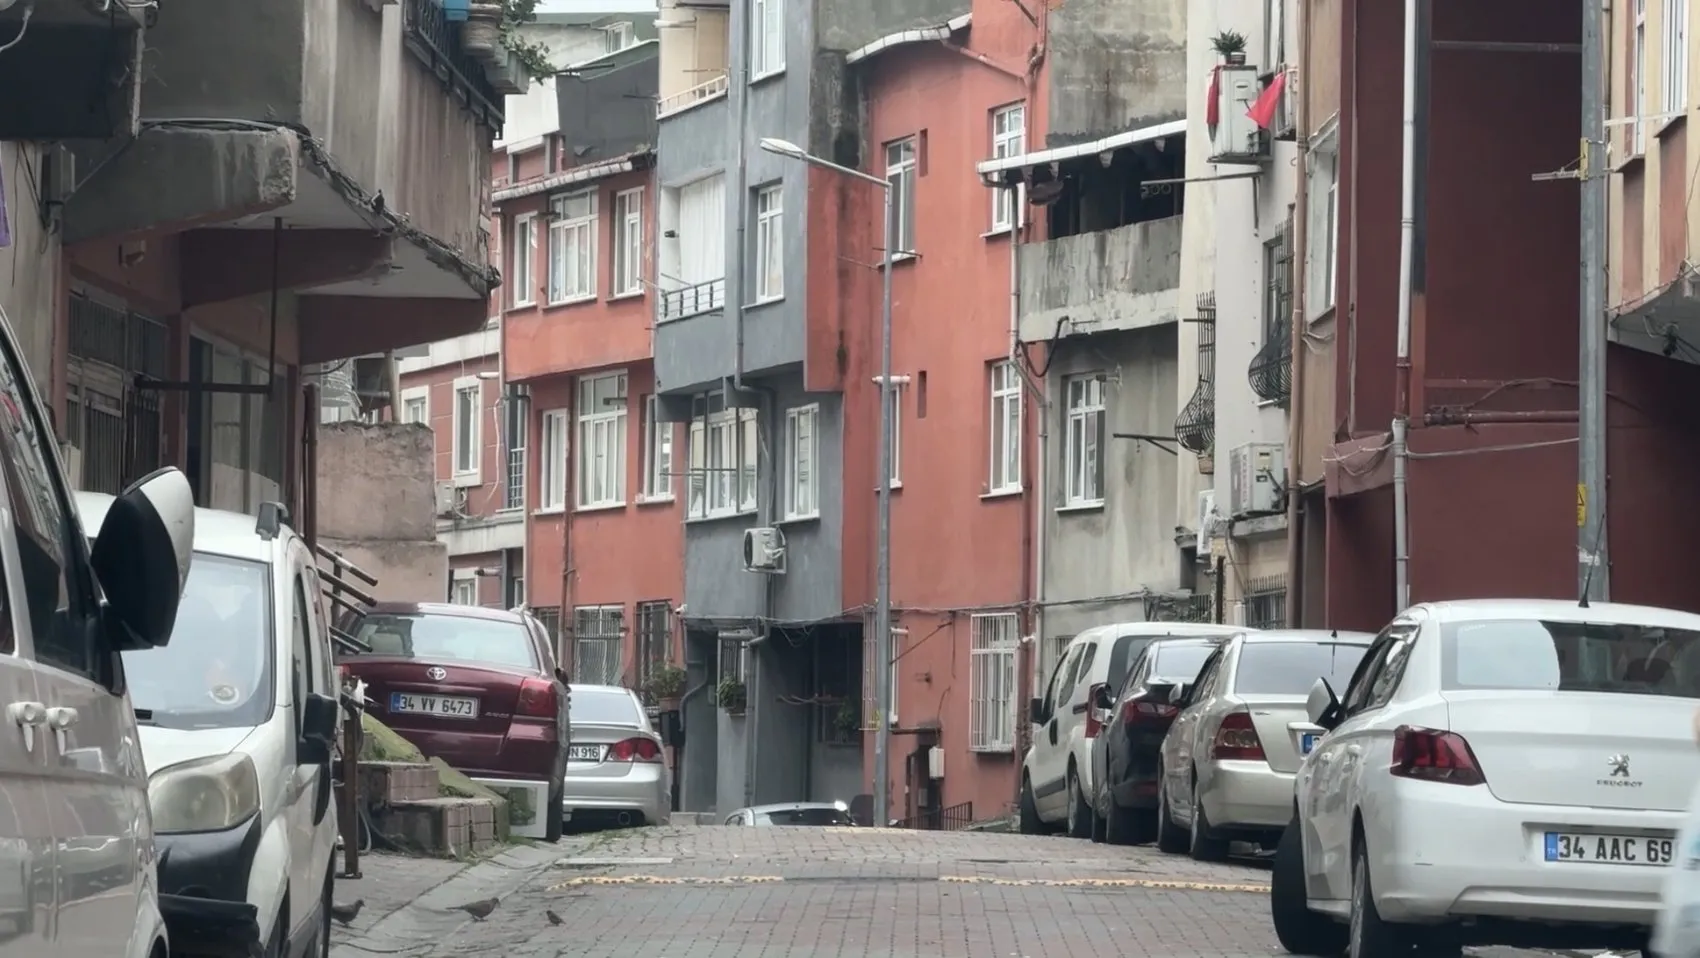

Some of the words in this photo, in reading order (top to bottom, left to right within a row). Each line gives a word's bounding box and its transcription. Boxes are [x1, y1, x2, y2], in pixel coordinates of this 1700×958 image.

[400, 696, 415, 710] 34
[421, 697, 436, 711] VV
[442, 699, 472, 714] 6473
[581, 747, 598, 758] 916
[1559, 836, 1585, 859] 34
[1595, 836, 1636, 861] AAC
[1646, 839, 1673, 864] 69
